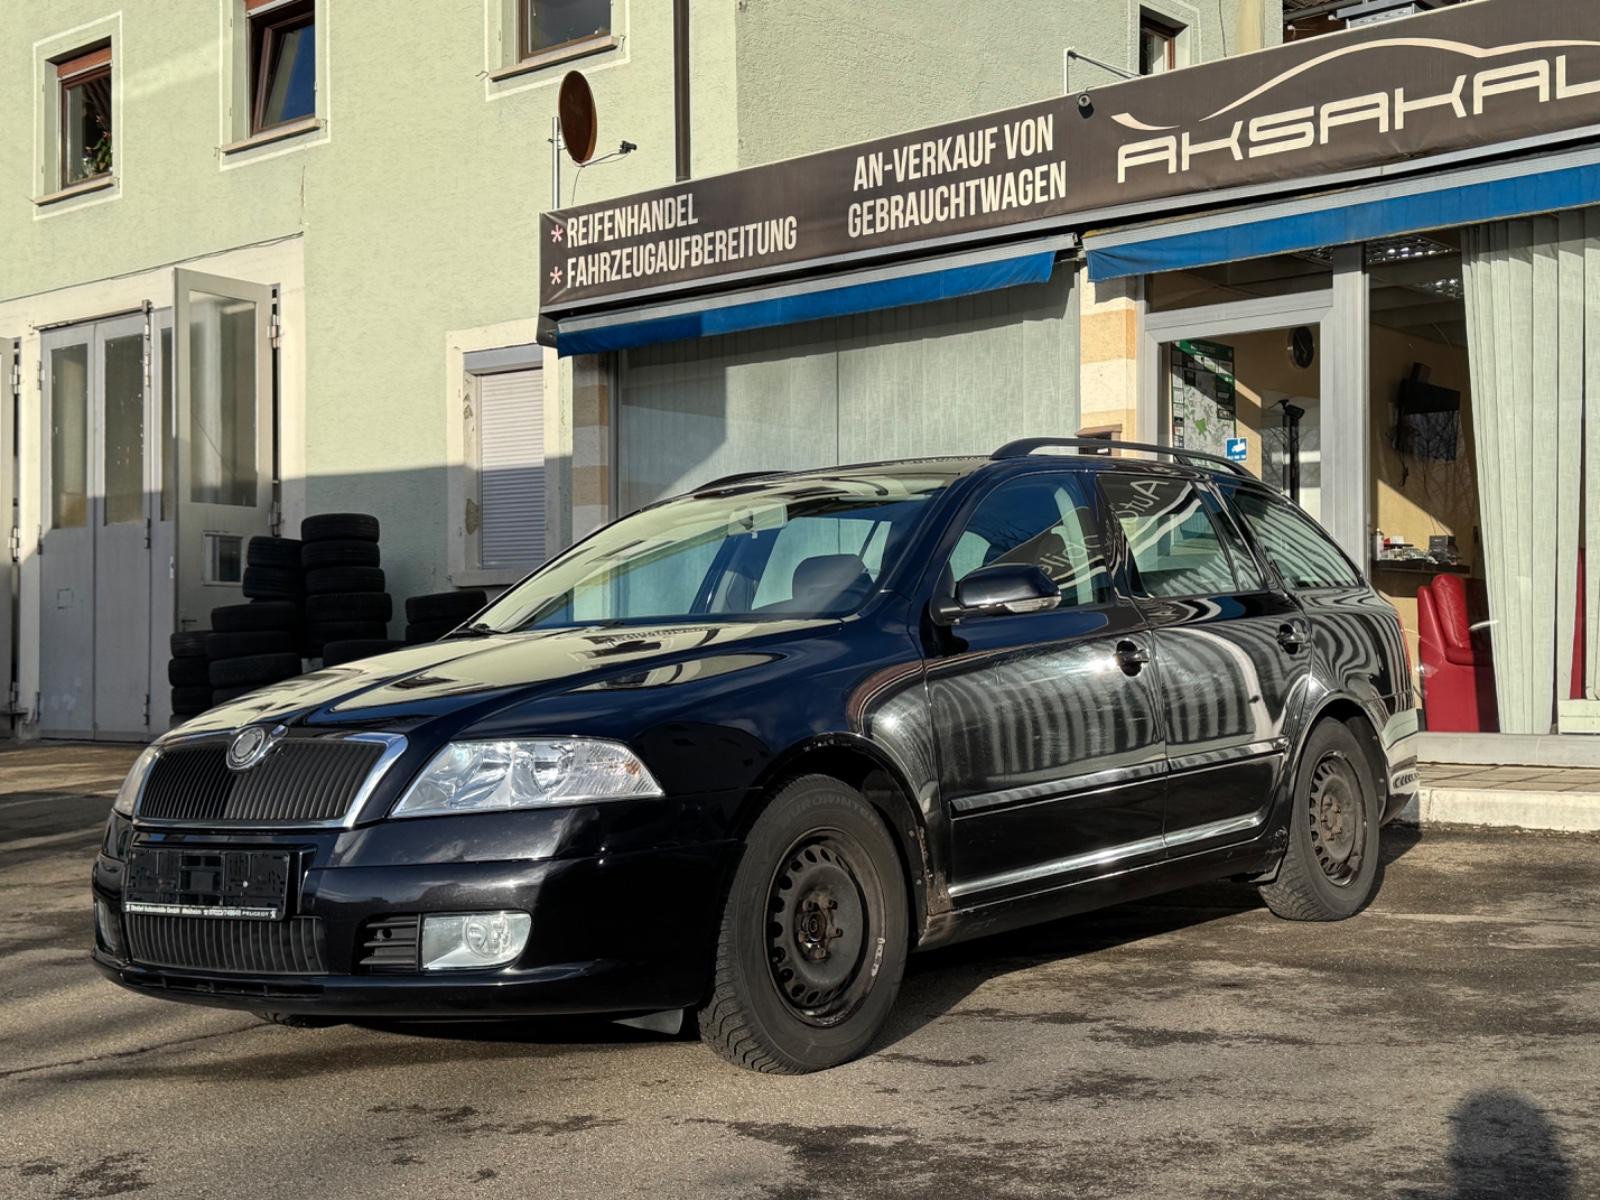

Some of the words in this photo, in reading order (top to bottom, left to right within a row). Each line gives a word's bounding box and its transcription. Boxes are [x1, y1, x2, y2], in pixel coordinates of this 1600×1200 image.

[853, 141, 997, 190] AN-VERKAUF
[1004, 113, 1053, 158] VON
[1117, 55, 1600, 183] AKSAKAL
[566, 193, 698, 249] REIFENHANDEL
[848, 161, 1066, 239] GEBRAUCHTWAGEN
[566, 215, 797, 289] FAHRZEUGAUFBEREITUNG
